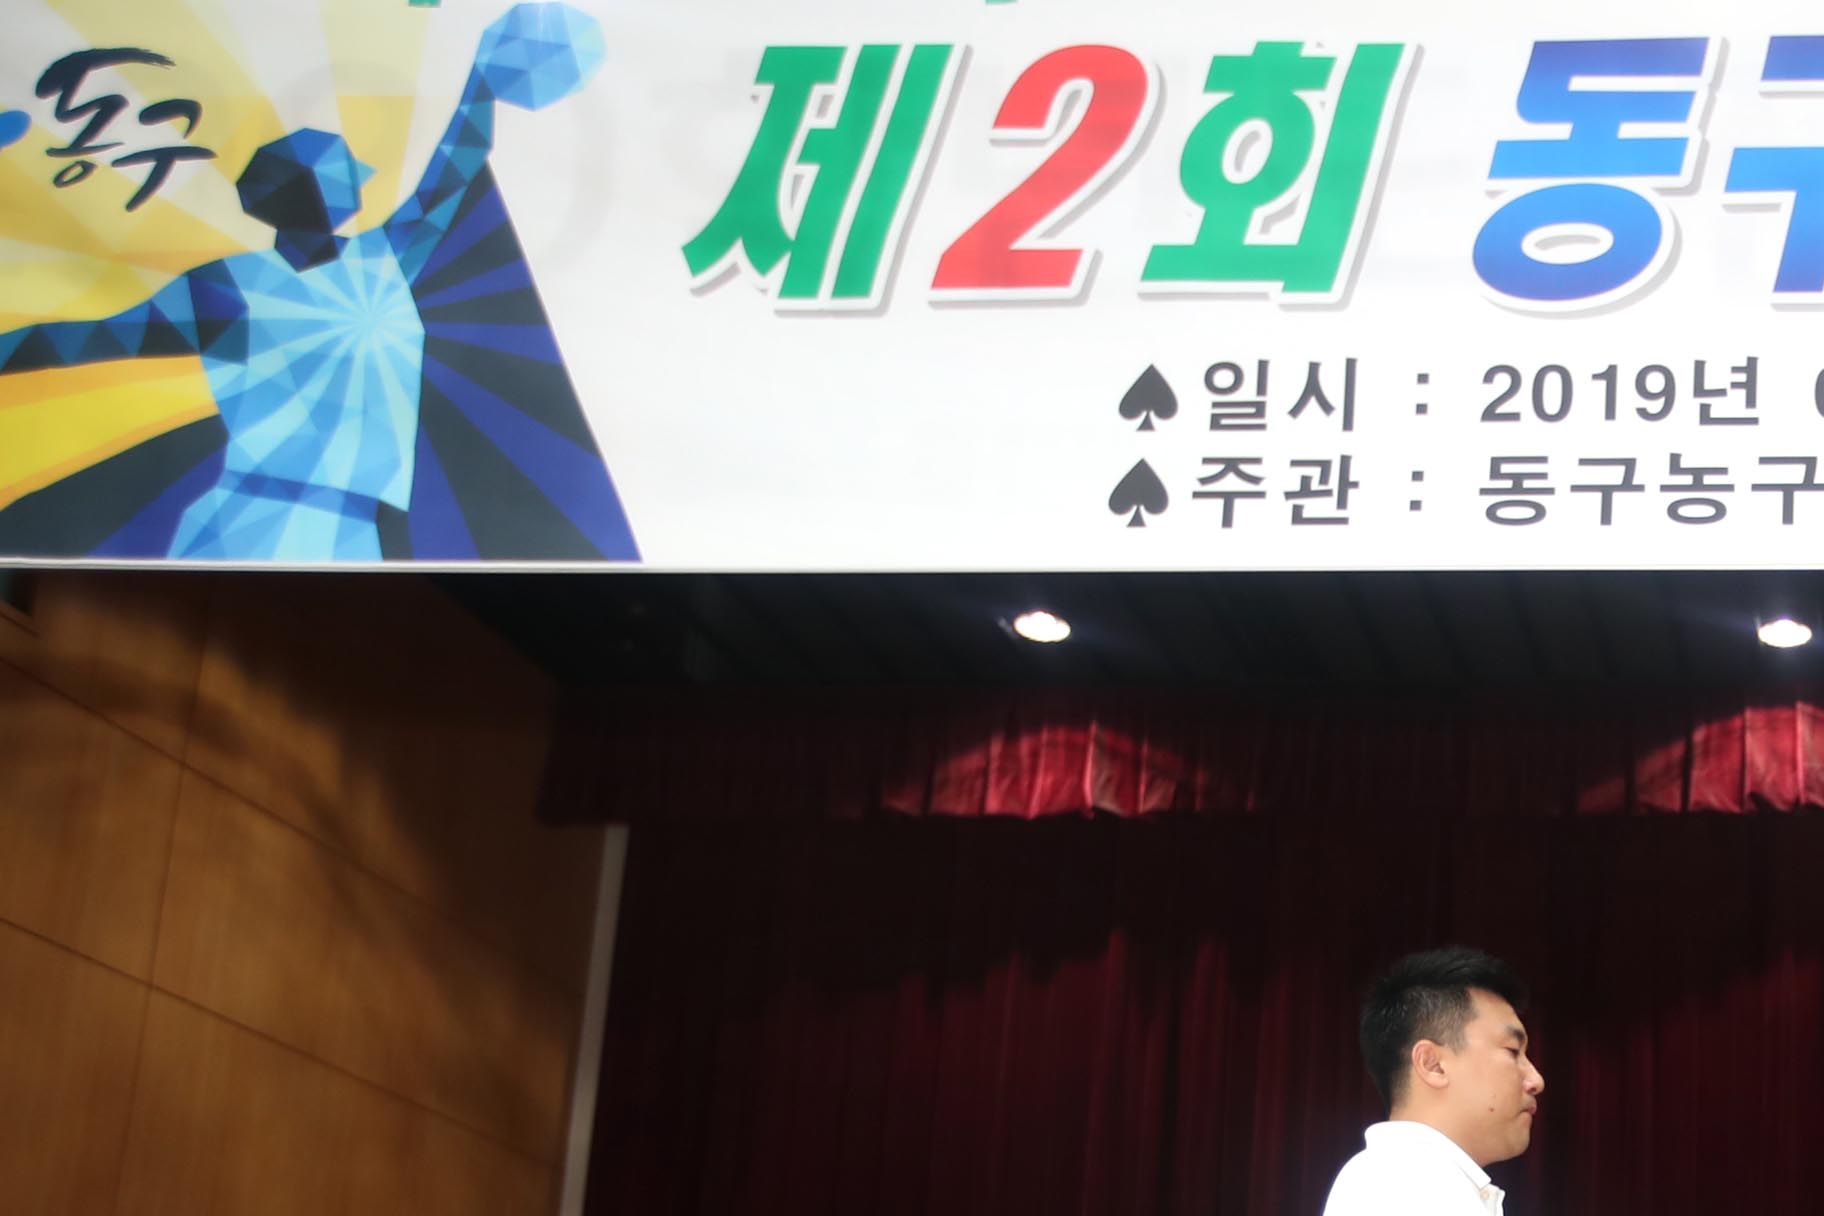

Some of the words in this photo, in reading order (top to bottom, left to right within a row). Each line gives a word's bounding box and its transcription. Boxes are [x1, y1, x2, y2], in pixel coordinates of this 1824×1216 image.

[34, 46, 217, 212] 동구
[681, 41, 1405, 299] 제2회
[1203, 357, 1358, 431] 일시
[1481, 355, 1760, 426] 2019년
[1191, 454, 1360, 528] 주관
